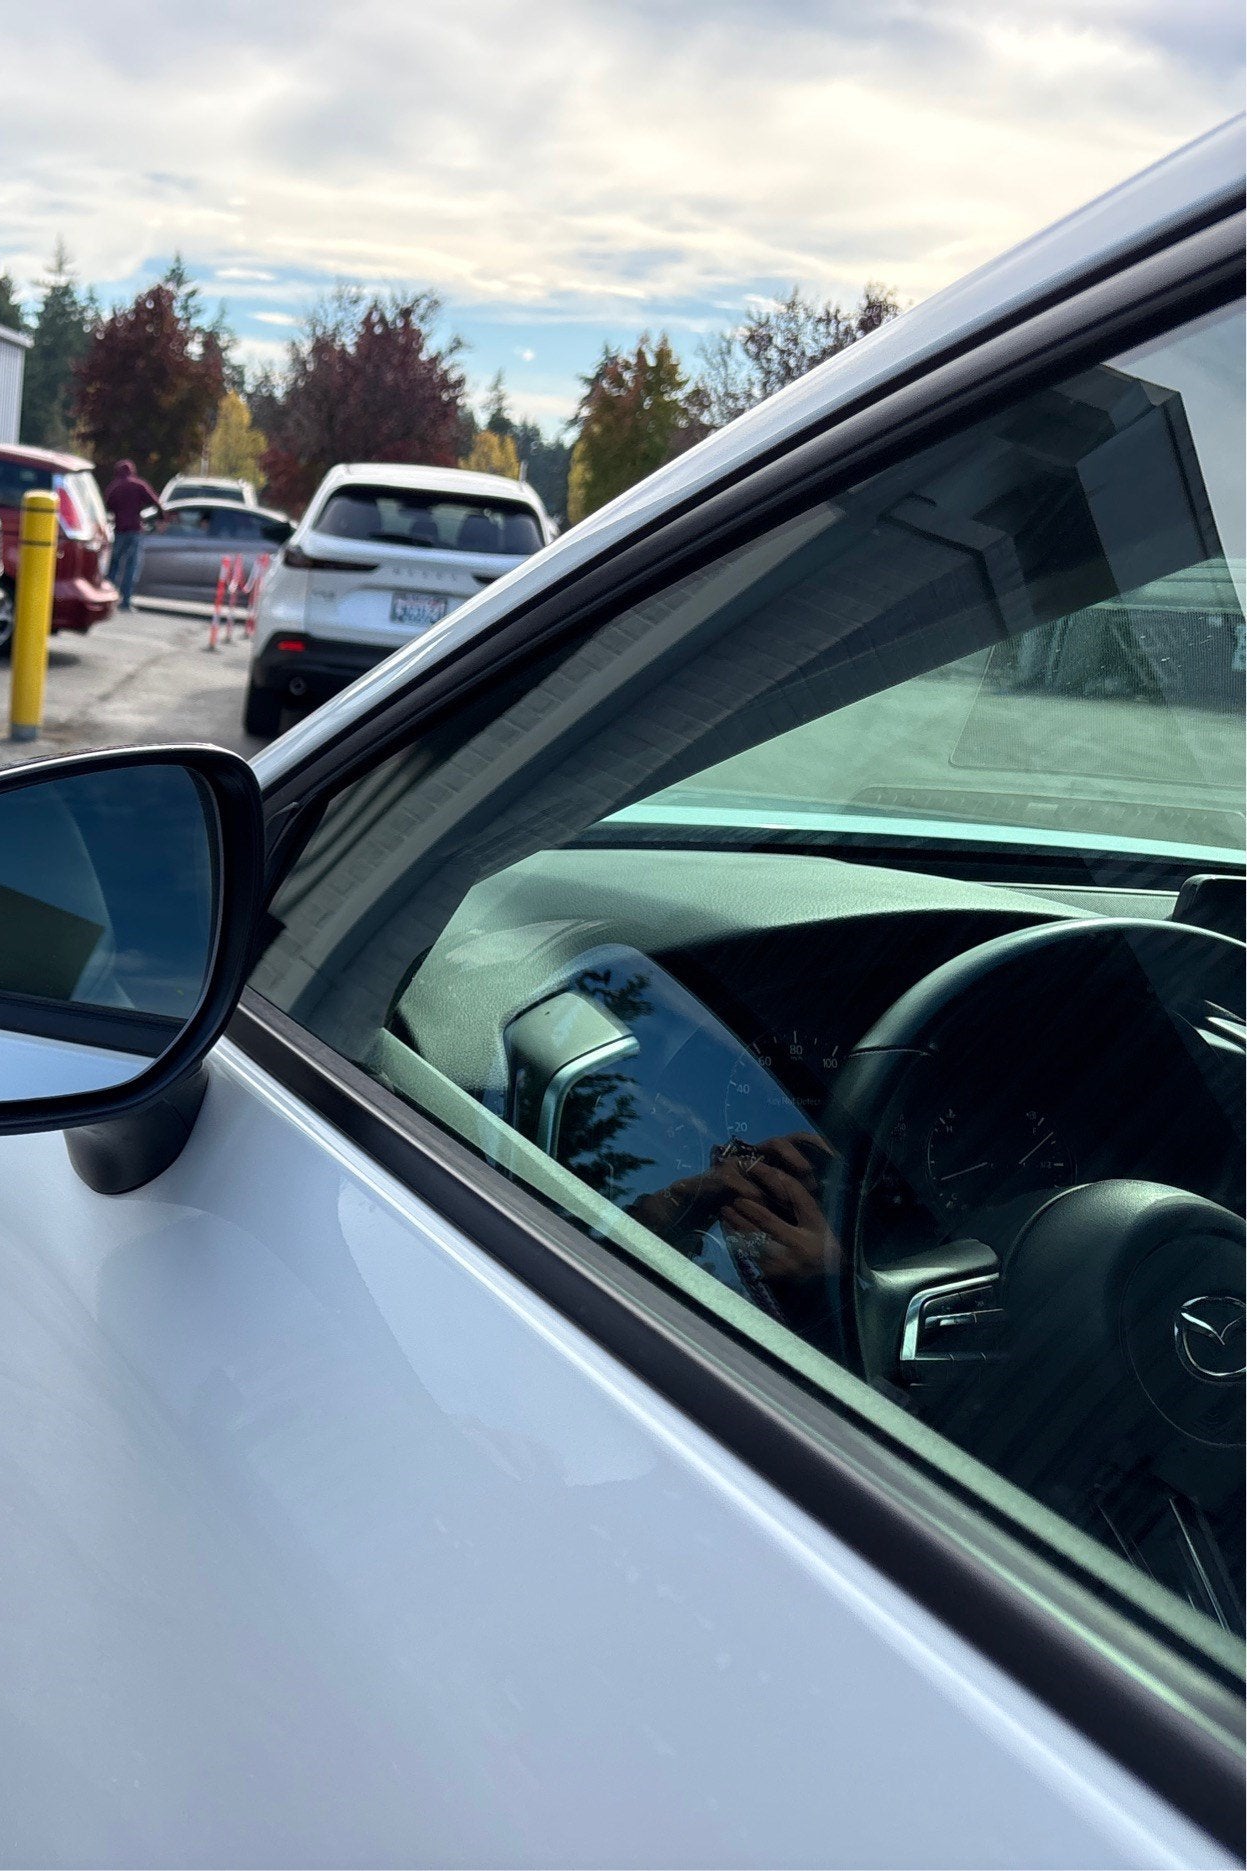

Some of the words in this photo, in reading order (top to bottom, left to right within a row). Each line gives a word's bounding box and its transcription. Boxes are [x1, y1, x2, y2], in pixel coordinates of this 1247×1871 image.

[789, 1044, 803, 1055] 80
[758, 1056, 772, 1066] 60
[822, 1058, 838, 1068] 100
[736, 1084, 750, 1094] 40
[734, 1121, 748, 1132] 20
